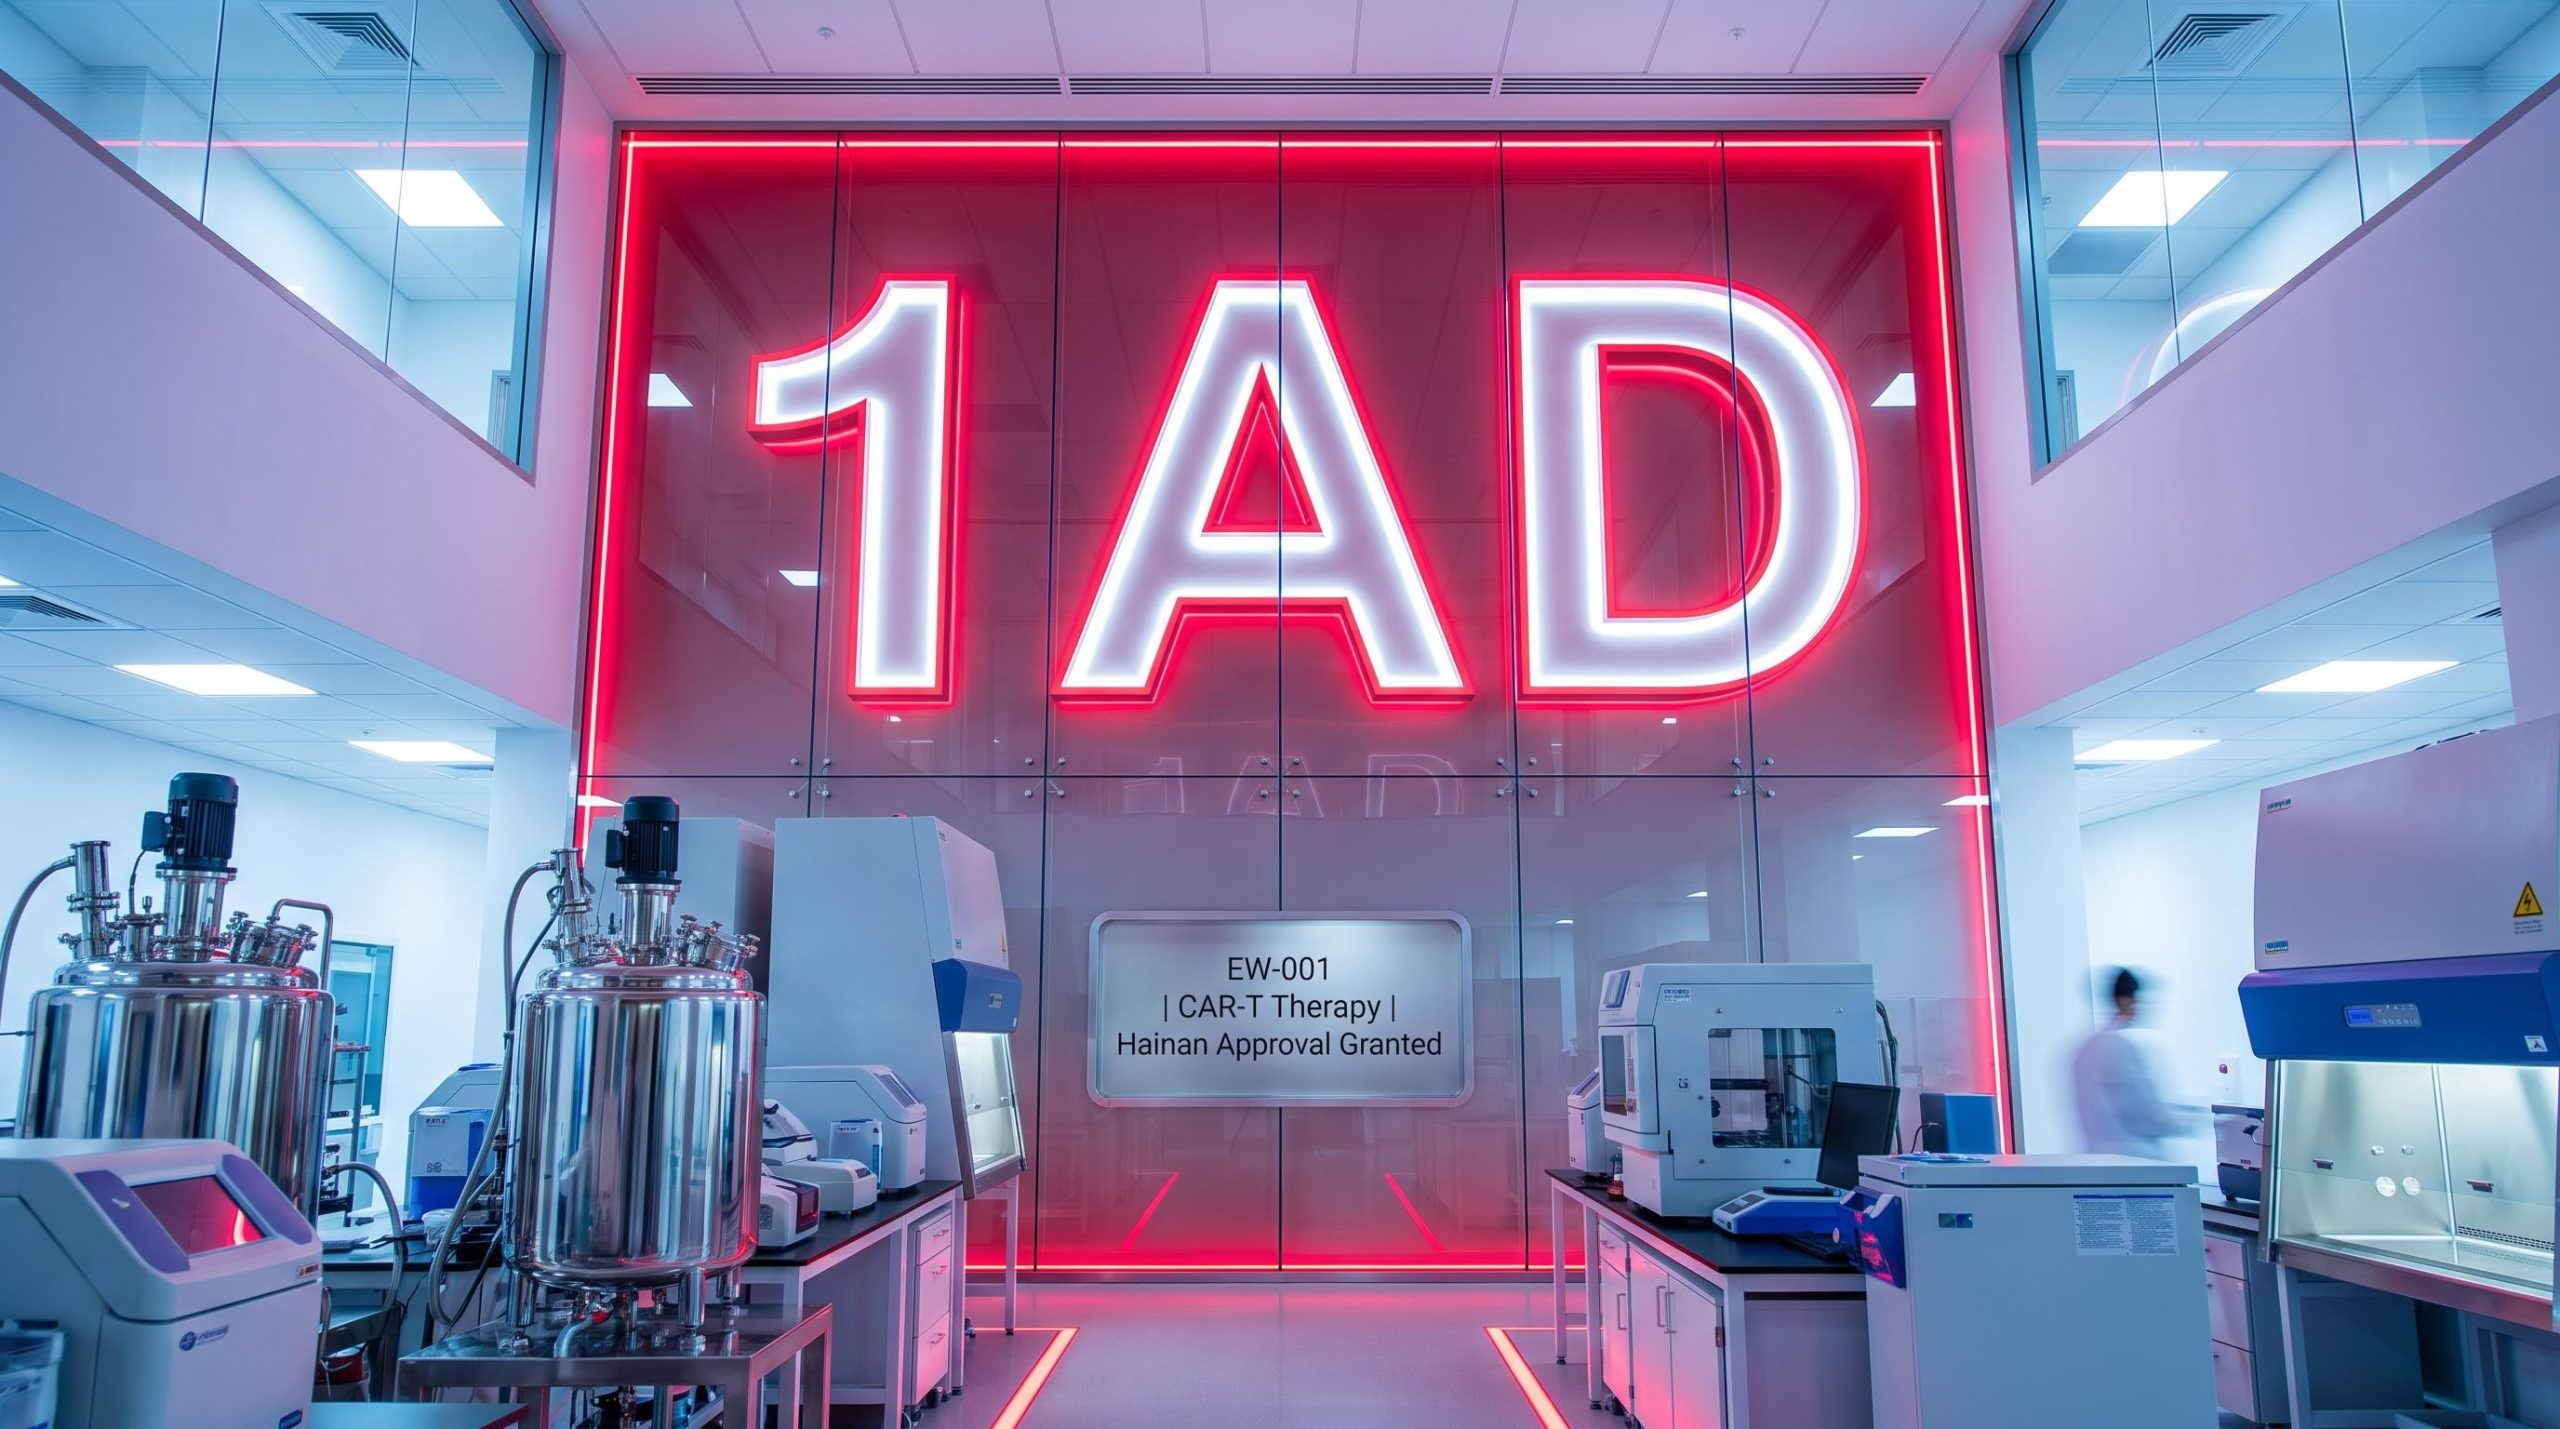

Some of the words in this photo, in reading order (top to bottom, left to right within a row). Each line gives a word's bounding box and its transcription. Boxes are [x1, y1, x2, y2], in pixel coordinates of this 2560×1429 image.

[748, 272, 1868, 702] 1AD
[1228, 956, 1328, 981] EW-001
[1178, 994, 1264, 1019] CAR-T
[1271, 993, 1381, 1025] Therapy
[1118, 1032, 1208, 1056] Hainan
[1216, 1031, 1330, 1062] Approval
[1340, 1030, 1442, 1056] Granted
